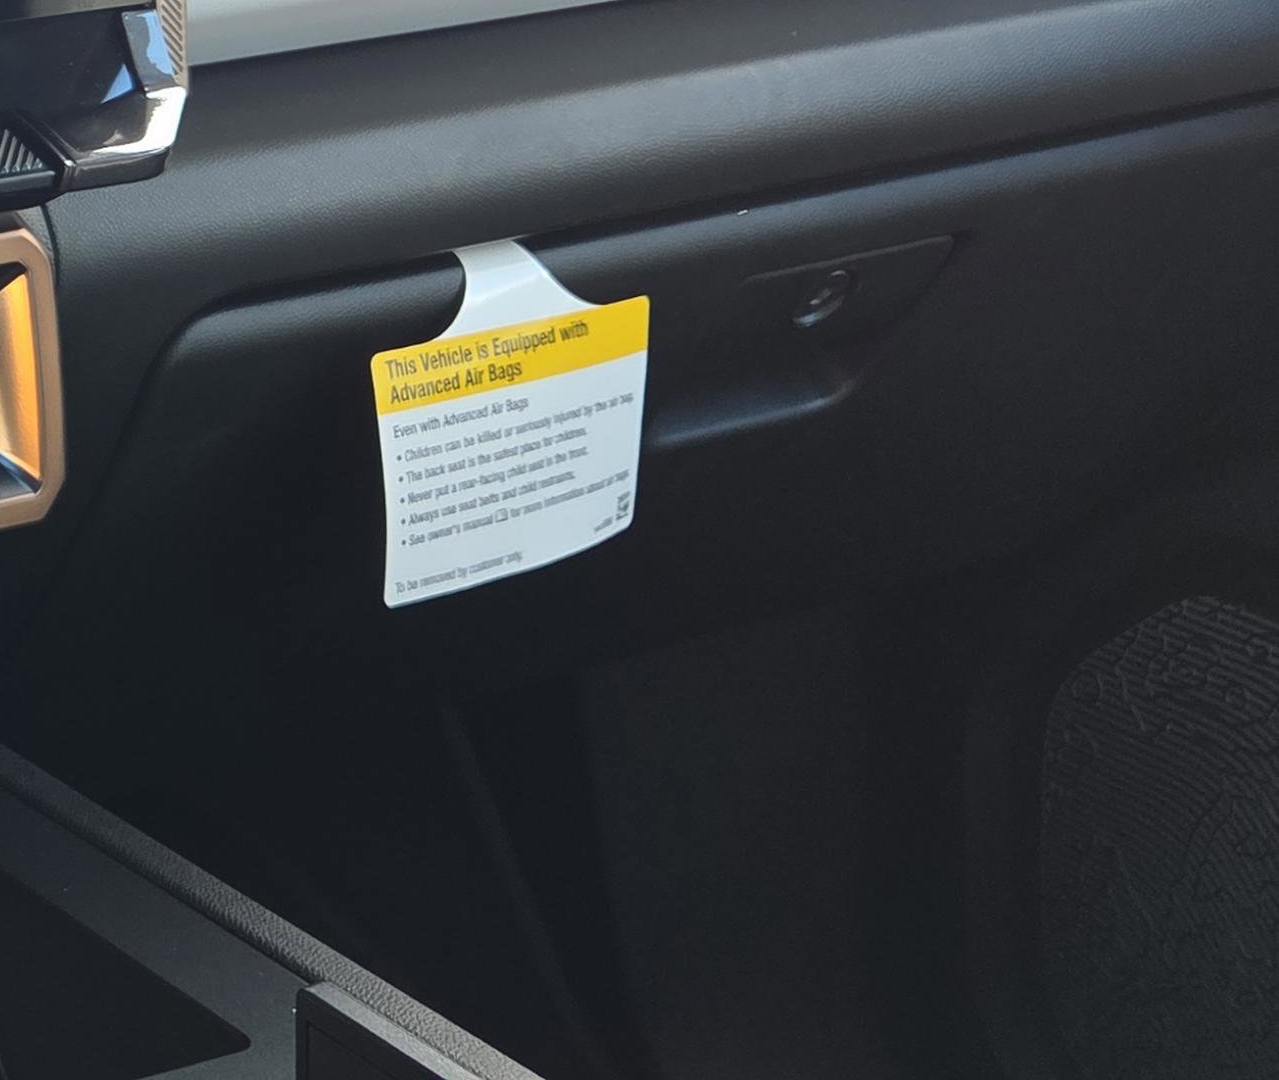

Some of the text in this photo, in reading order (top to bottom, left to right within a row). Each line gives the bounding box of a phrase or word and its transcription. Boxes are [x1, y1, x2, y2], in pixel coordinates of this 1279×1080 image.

[385, 320, 589, 379] This Vehicle is Equipped with
[390, 362, 522, 404] Advanced Air Bags
[393, 398, 529, 439] Even with Advanced Air Bags
[405, 444, 443, 462] Children
[445, 440, 462, 453] can
[463, 436, 476, 448] be
[477, 428, 502, 443] killed
[406, 470, 423, 484] The
[424, 464, 445, 479] back
[407, 489, 433, 505] Never
[408, 509, 440, 526] Always
